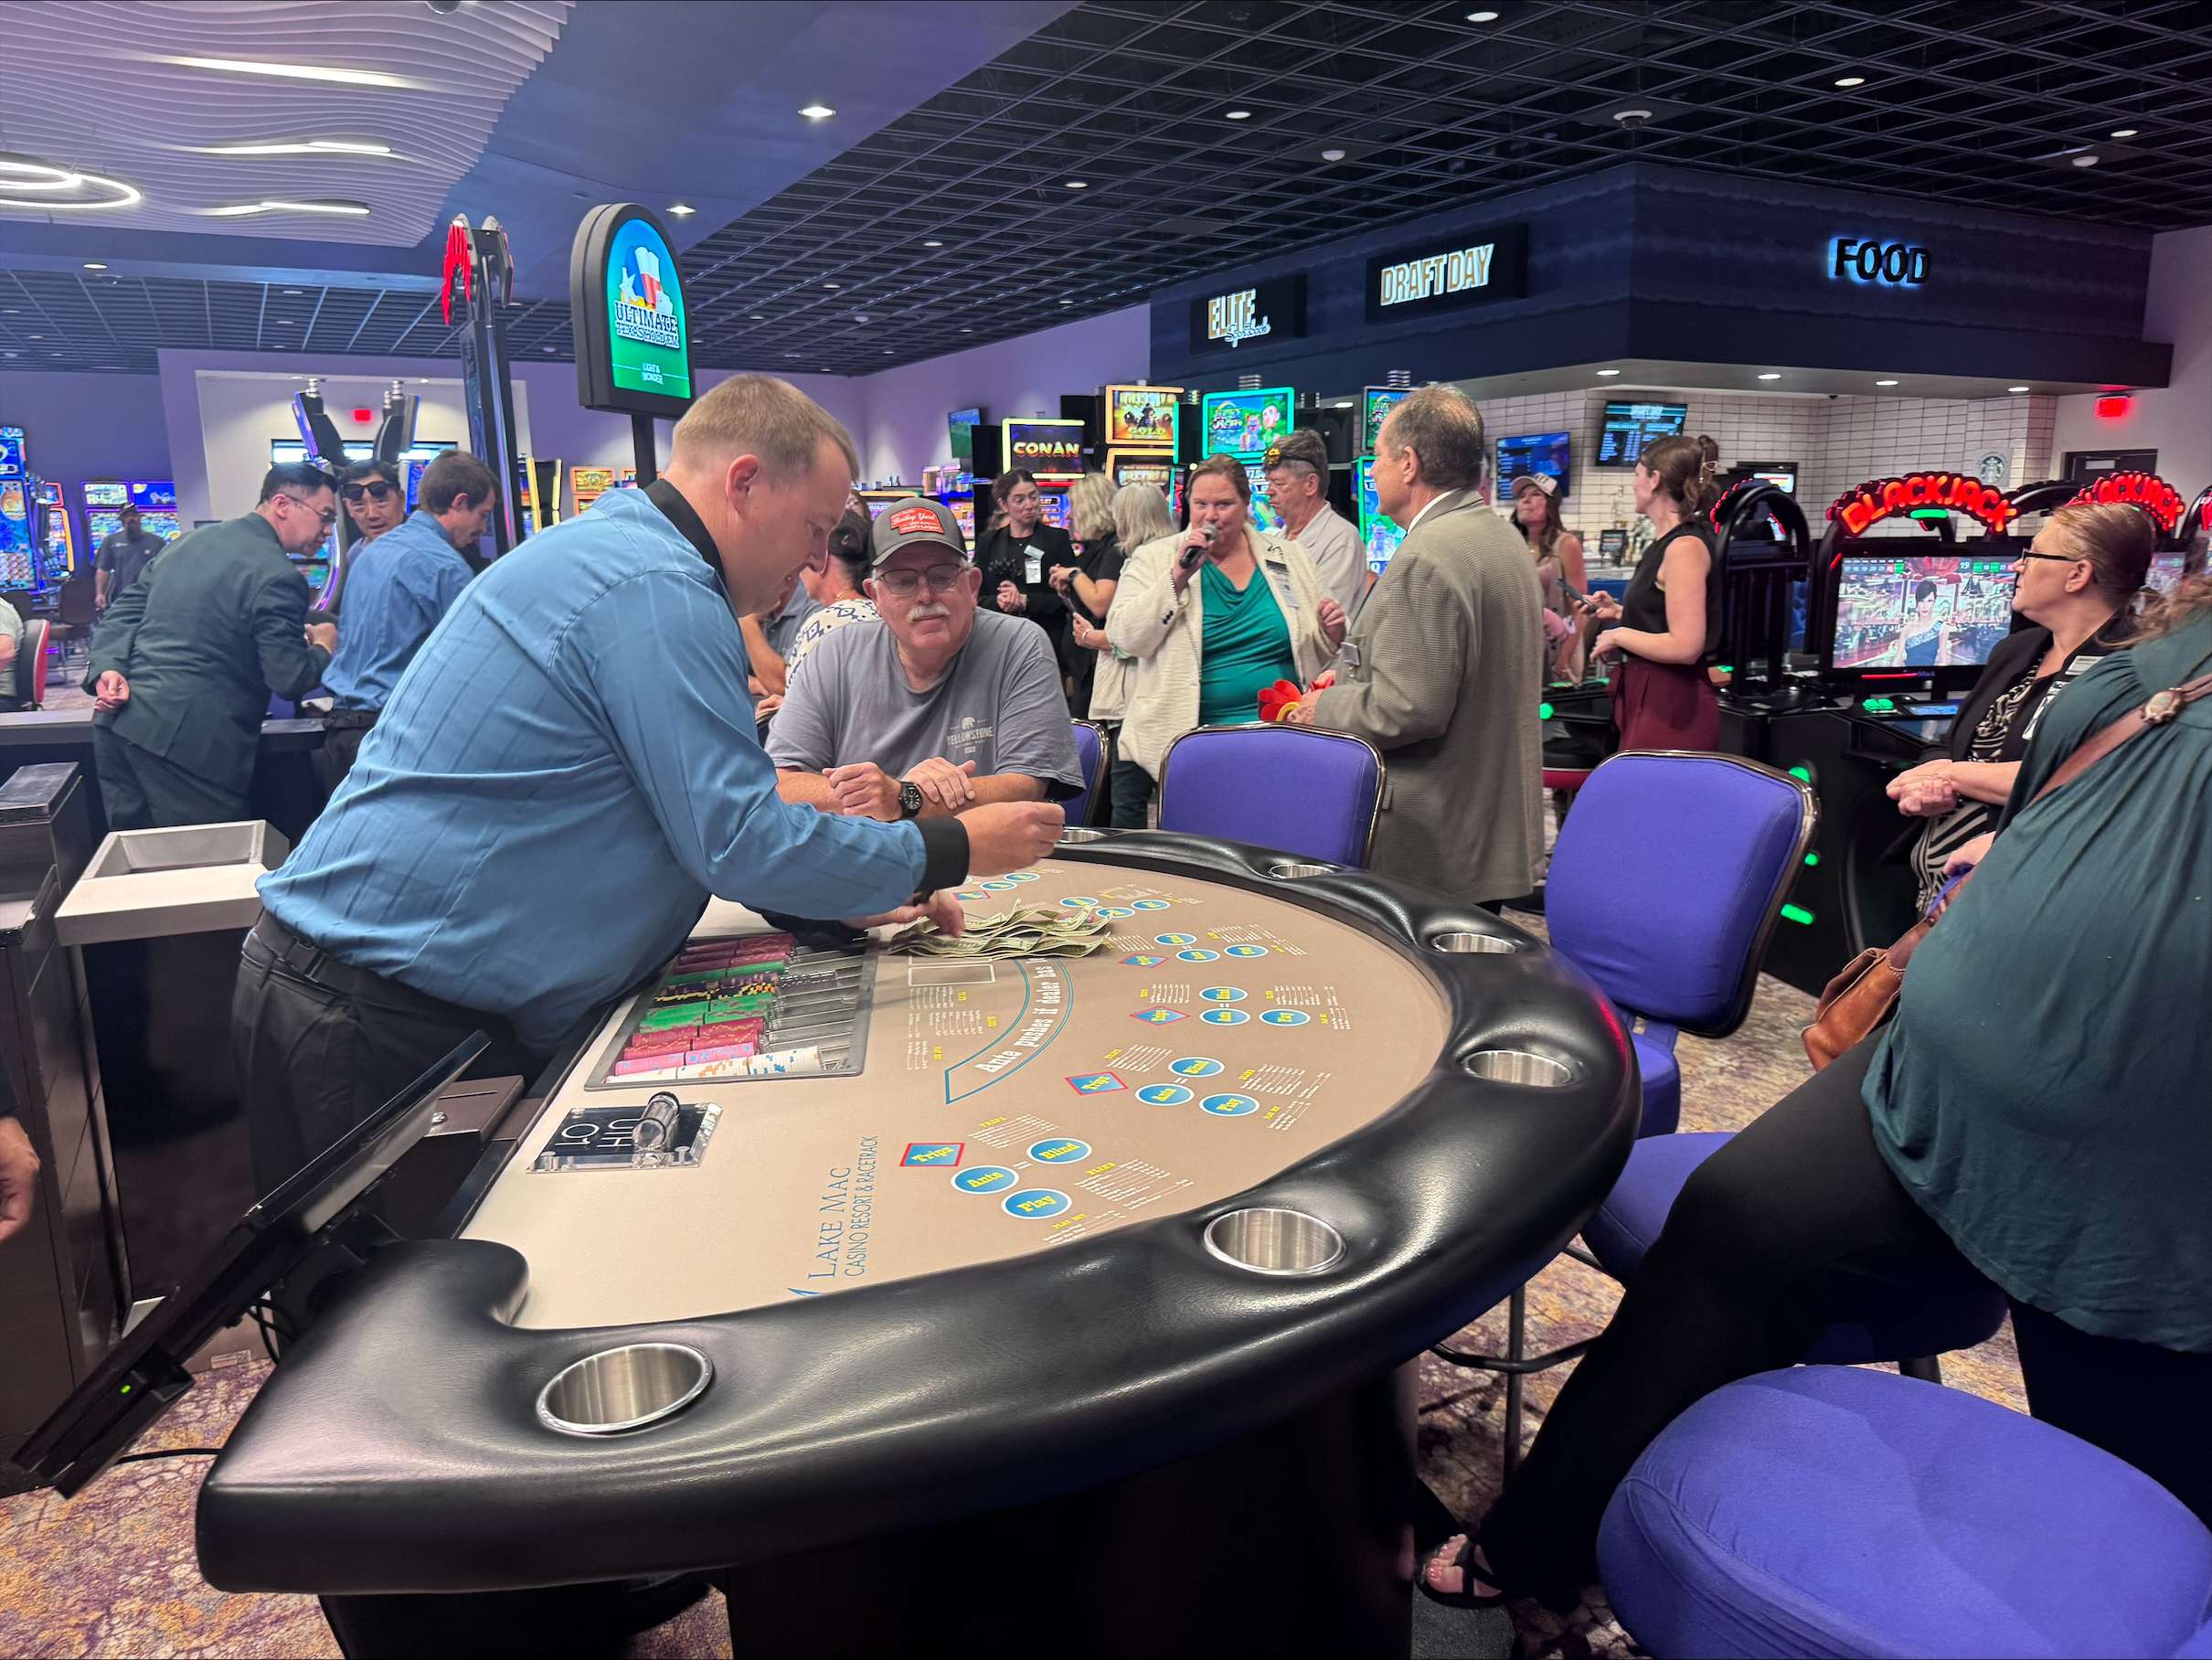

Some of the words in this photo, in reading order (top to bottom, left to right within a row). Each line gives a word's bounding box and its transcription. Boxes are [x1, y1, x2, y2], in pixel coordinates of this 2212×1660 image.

[1832, 238, 1930, 284] FOOD
[1380, 253, 1448, 306] DRAFT
[1446, 243, 1494, 293] DAY
[615, 303, 677, 334] ULTIMATE
[1207, 289, 1256, 339] ELITE
[1014, 442, 1080, 457] CONAN
[1842, 475, 2017, 534] BLACKJACK
[946, 727, 994, 746] YELLOWSTONE
[1033, 965, 1058, 980] has
[1037, 982, 1061, 1005] dealer
[1031, 1007, 1058, 1016] if
[1015, 1018, 1054, 1049] pushes
[974, 1048, 1023, 1074] Ante
[1082, 1075, 1111, 1091] Trips
[1217, 1098, 1245, 1112] Play
[856, 1134, 878, 1182] RACETRACK
[913, 1145, 955, 1164] Trips
[1038, 1143, 1080, 1160] Blind
[859, 1183, 873, 1192] &
[967, 1171, 1005, 1188] Ante
[850, 1195, 873, 1230] RESORT
[1017, 1195, 1058, 1213] Play
[808, 1220, 844, 1280] LAKE
[844, 1231, 869, 1277] CASINO
